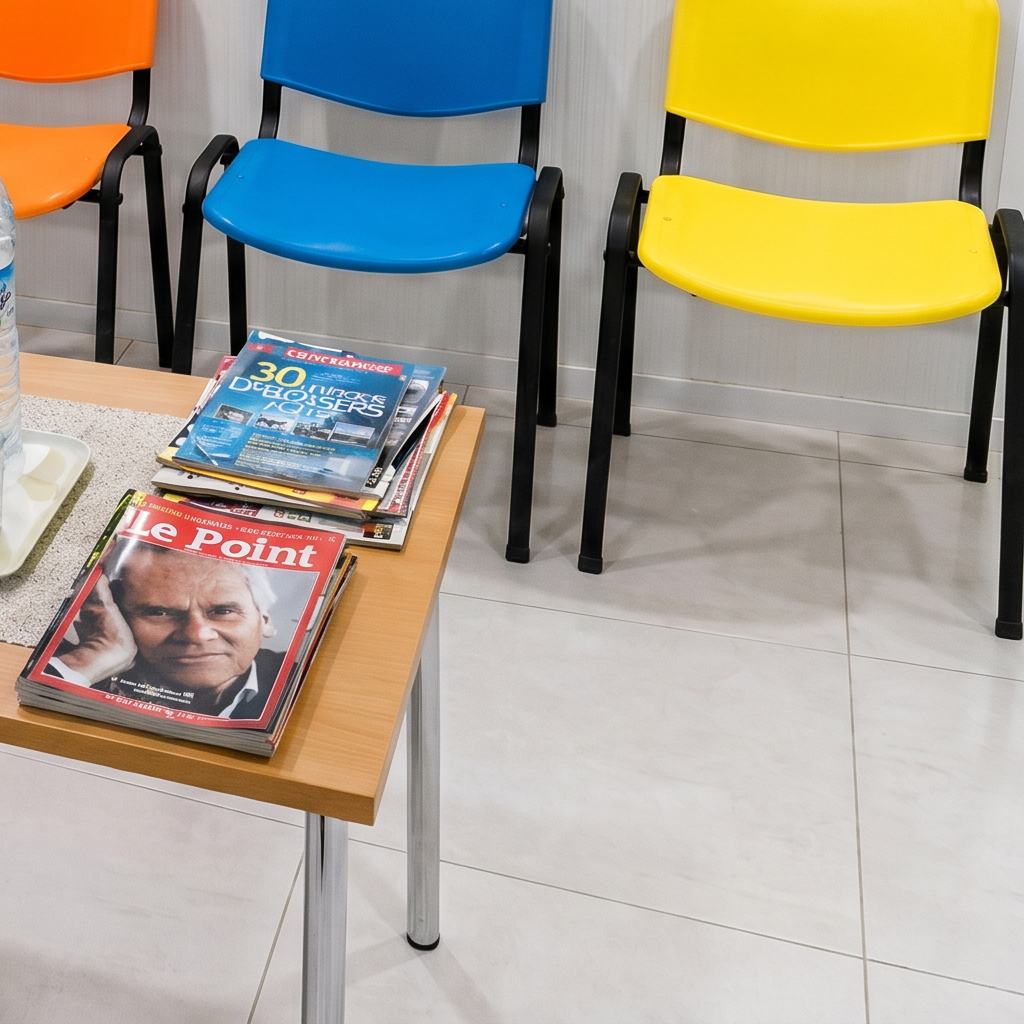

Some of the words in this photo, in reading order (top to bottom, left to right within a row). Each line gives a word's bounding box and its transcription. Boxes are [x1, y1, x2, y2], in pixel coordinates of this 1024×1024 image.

[249, 361, 307, 388] 30
[128, 508, 178, 543] Le
[185, 526, 317, 568] Point
